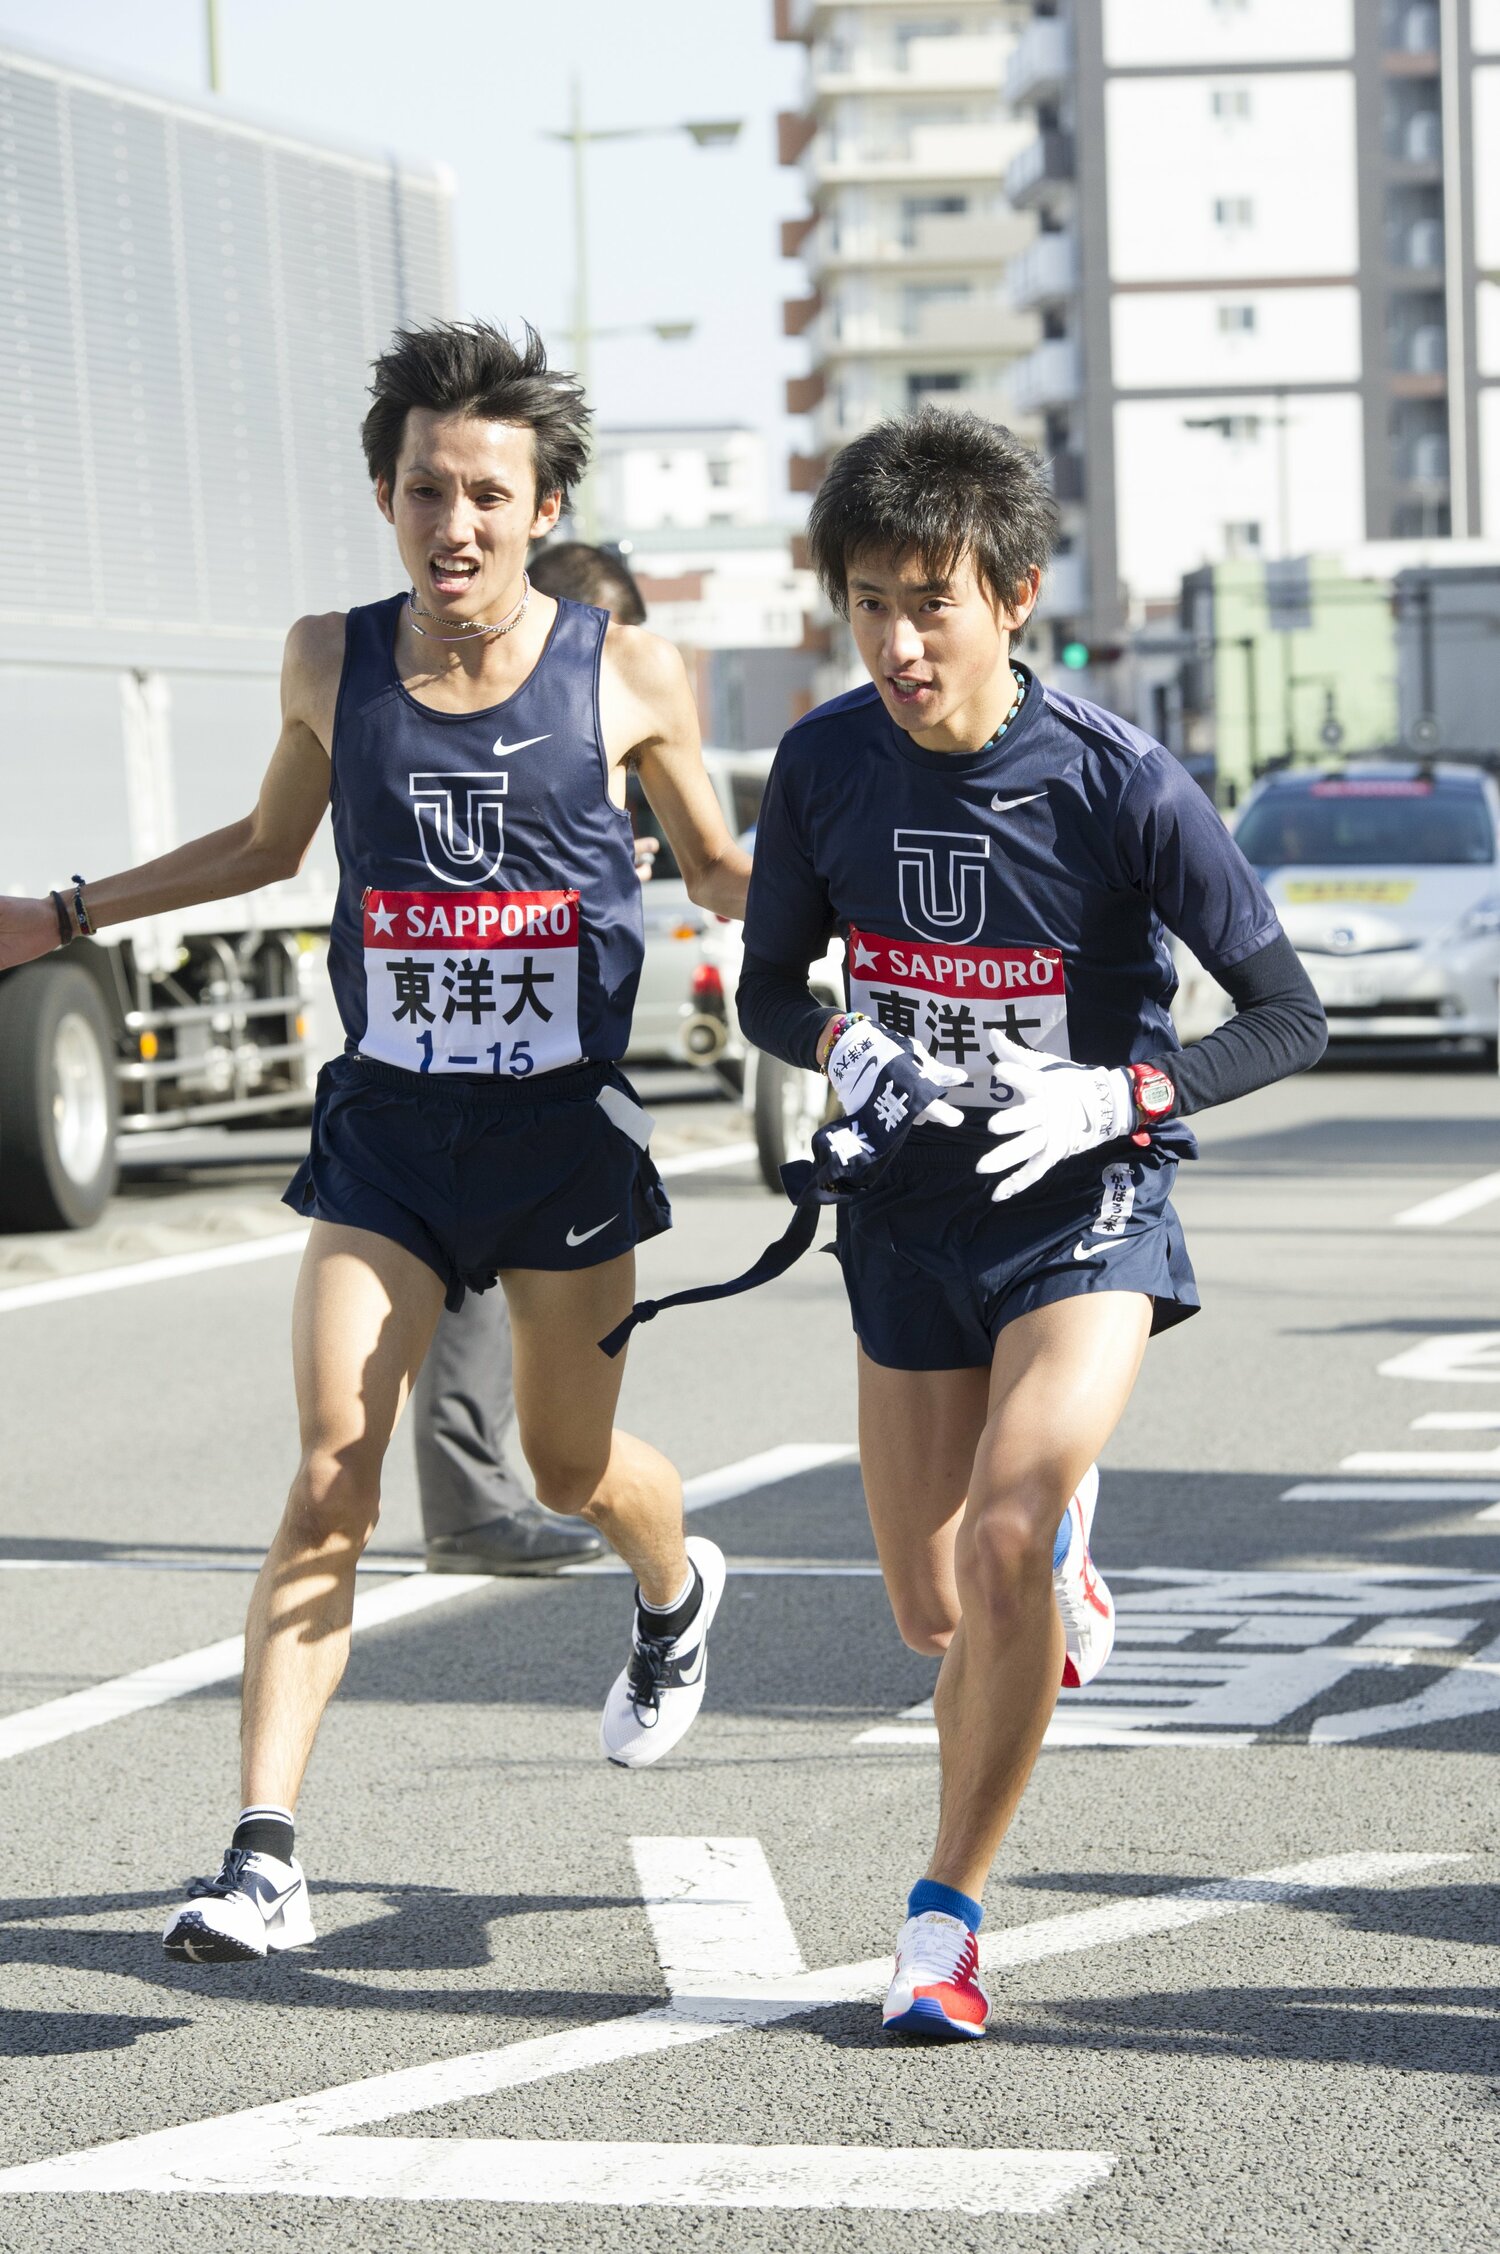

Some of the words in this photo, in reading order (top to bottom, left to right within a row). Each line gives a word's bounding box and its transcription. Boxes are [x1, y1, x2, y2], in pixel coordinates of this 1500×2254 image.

[407, 904, 571, 938] SAPPORO
[386, 957, 554, 1025] 東洋大
[889, 949, 1054, 992] SAPPORO
